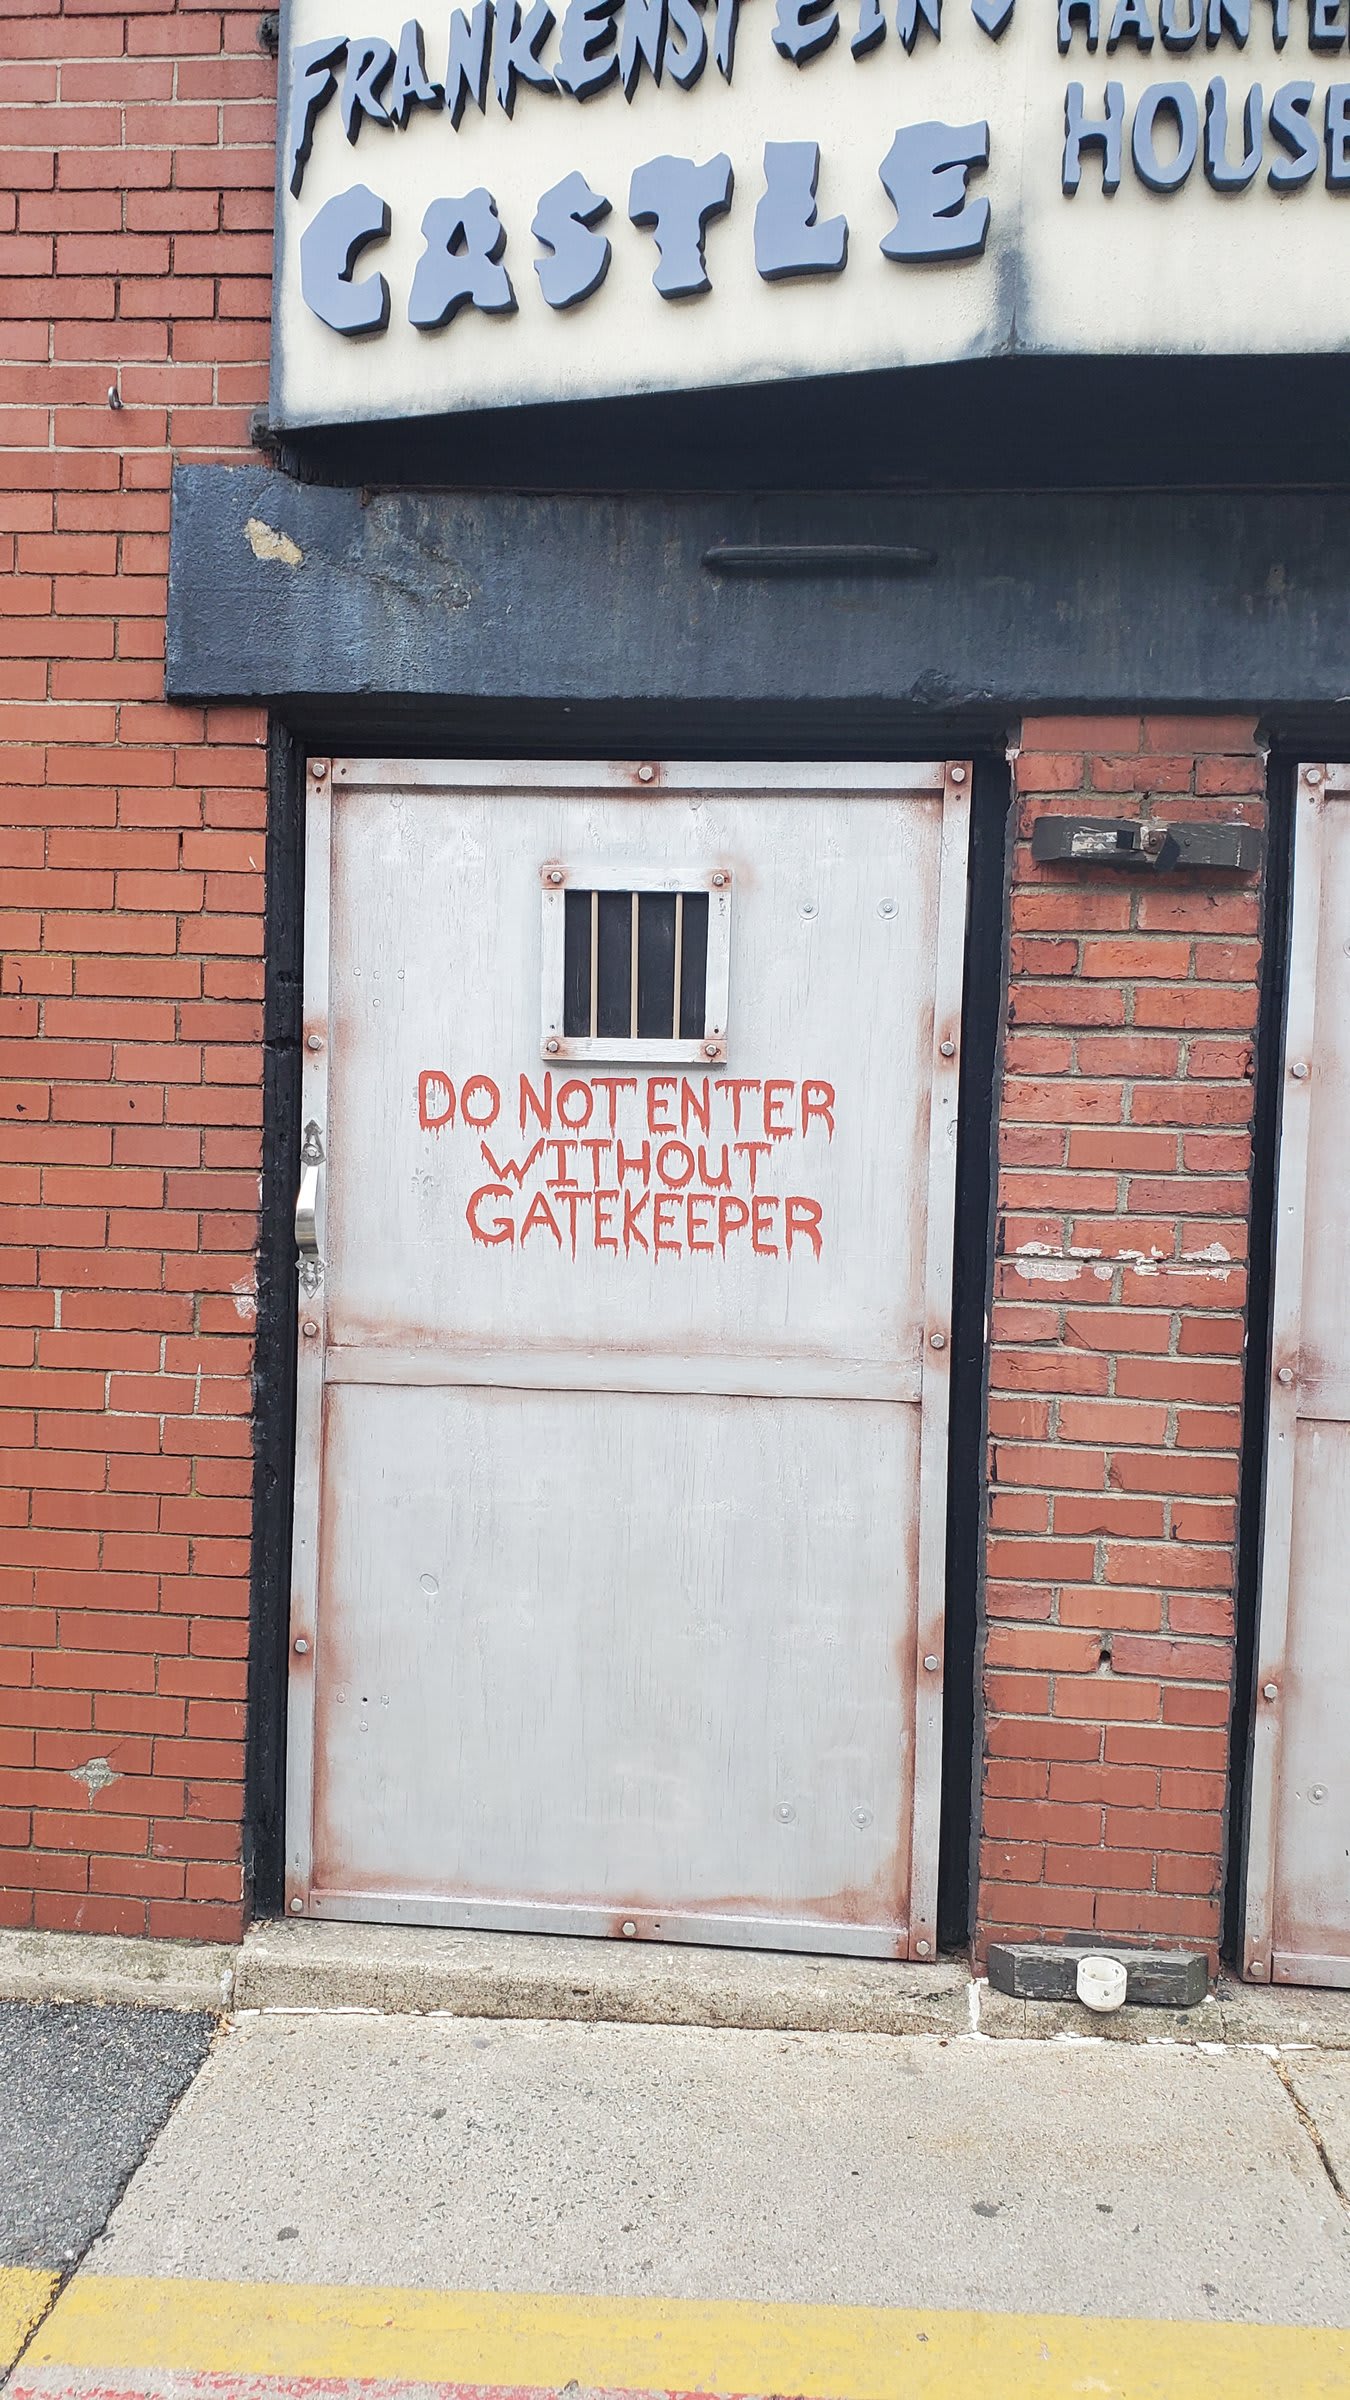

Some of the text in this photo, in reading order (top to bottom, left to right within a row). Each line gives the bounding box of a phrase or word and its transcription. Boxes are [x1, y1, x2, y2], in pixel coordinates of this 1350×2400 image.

[1057, 0, 1350, 54] HAUNTE
[1062, 75, 1350, 197] HOUSE
[299, 119, 992, 337] CASTLE
[418, 1069, 836, 1144] DO NOT ENTER
[480, 1137, 773, 1193] WITHOUT
[465, 1183, 824, 1264] GATEKEEPER
